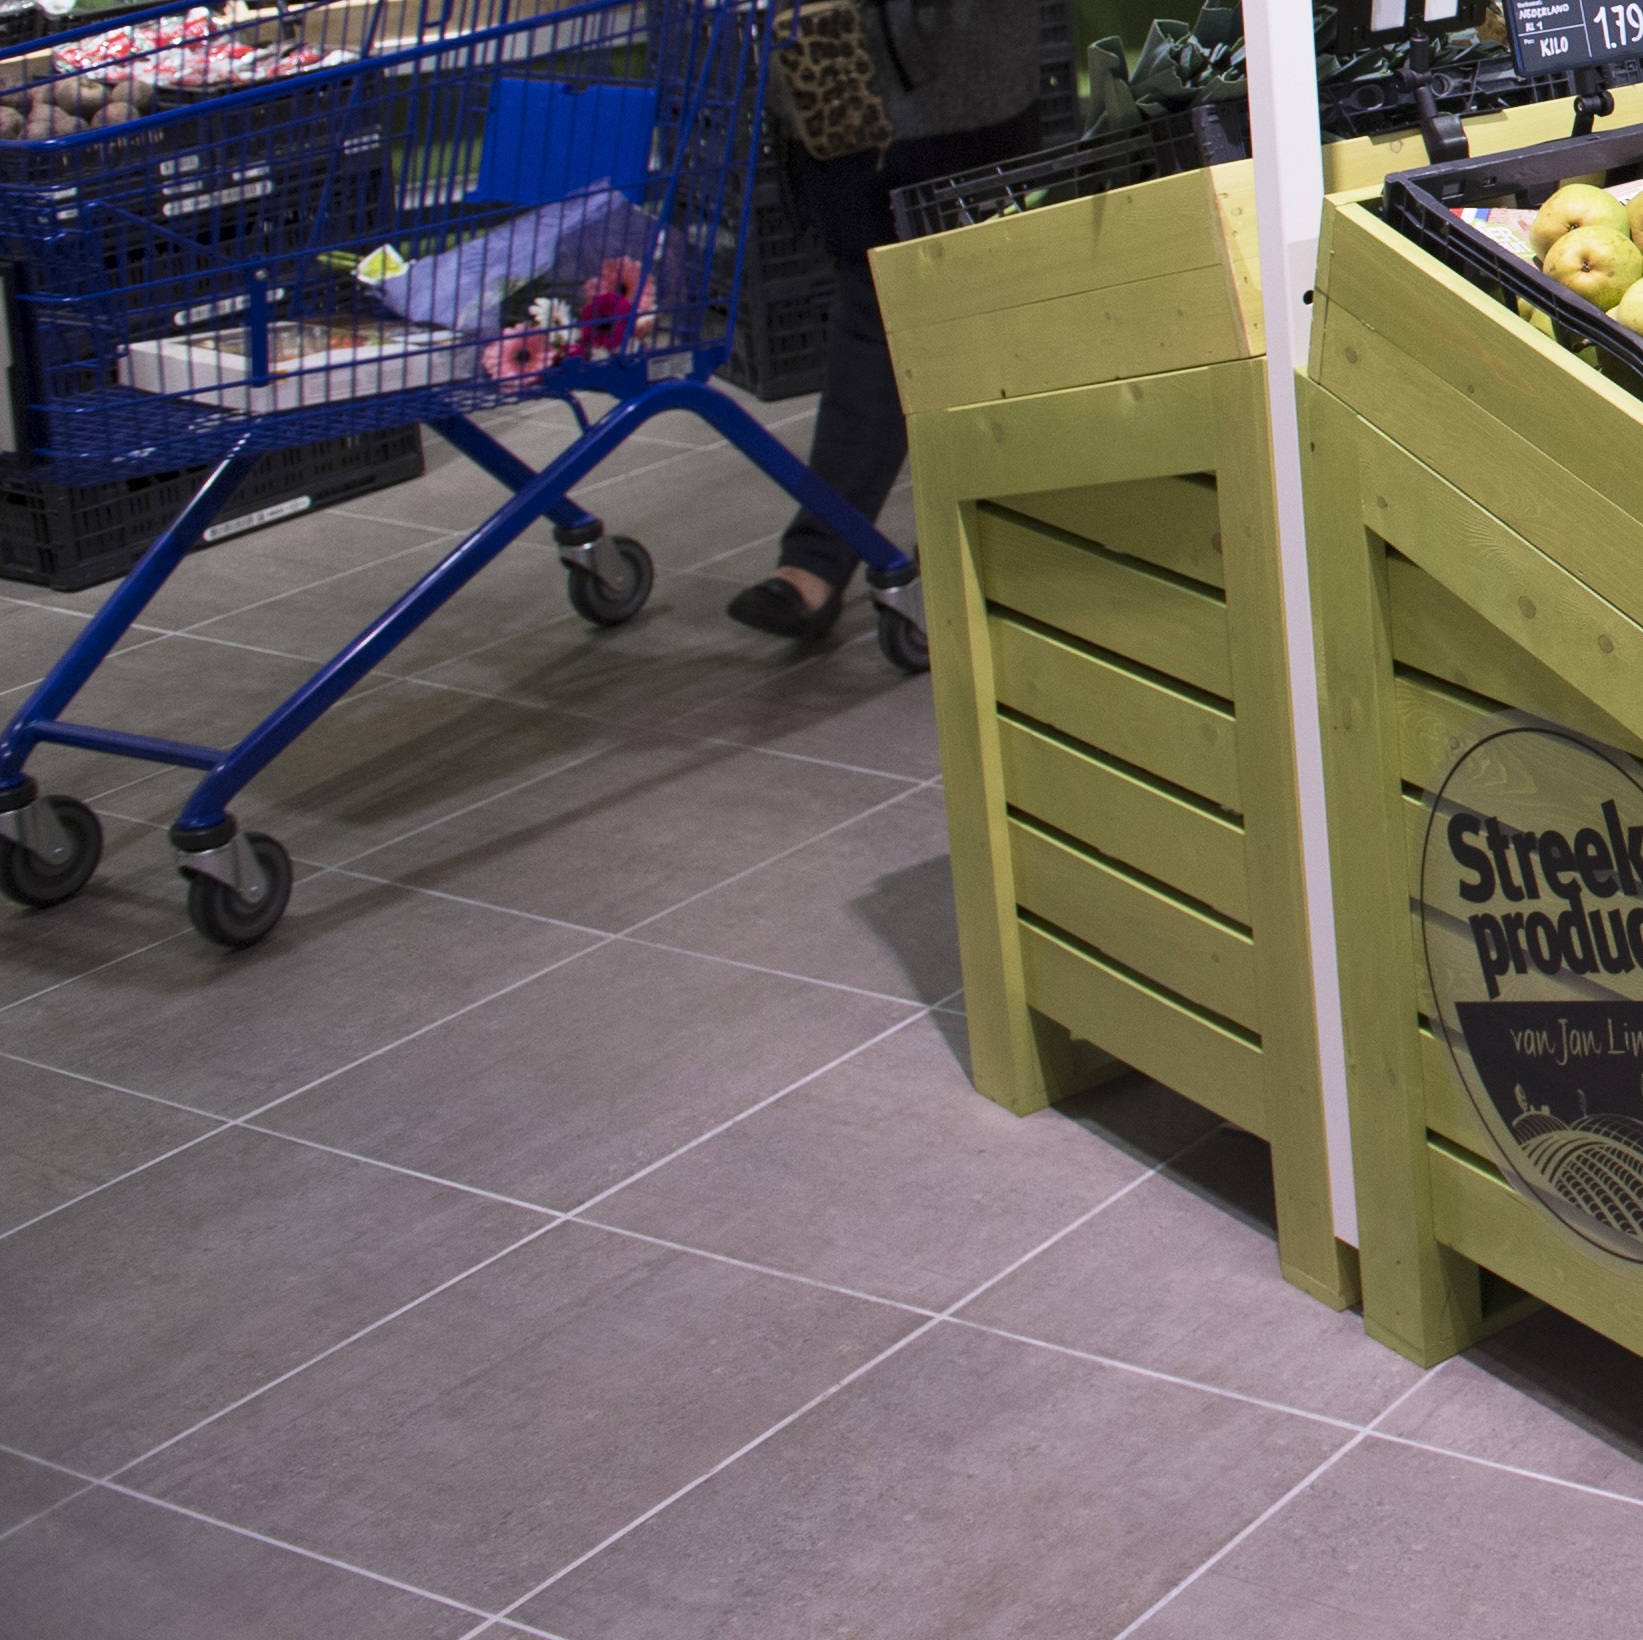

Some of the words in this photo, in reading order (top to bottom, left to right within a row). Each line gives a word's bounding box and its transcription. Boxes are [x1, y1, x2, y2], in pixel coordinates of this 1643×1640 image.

[1519, 3, 1570, 20] NEDERLAND
[1540, 36, 1569, 57] KILO
[1510, 1028, 1555, 1056] van
[1556, 1018, 1601, 1065] Jan
